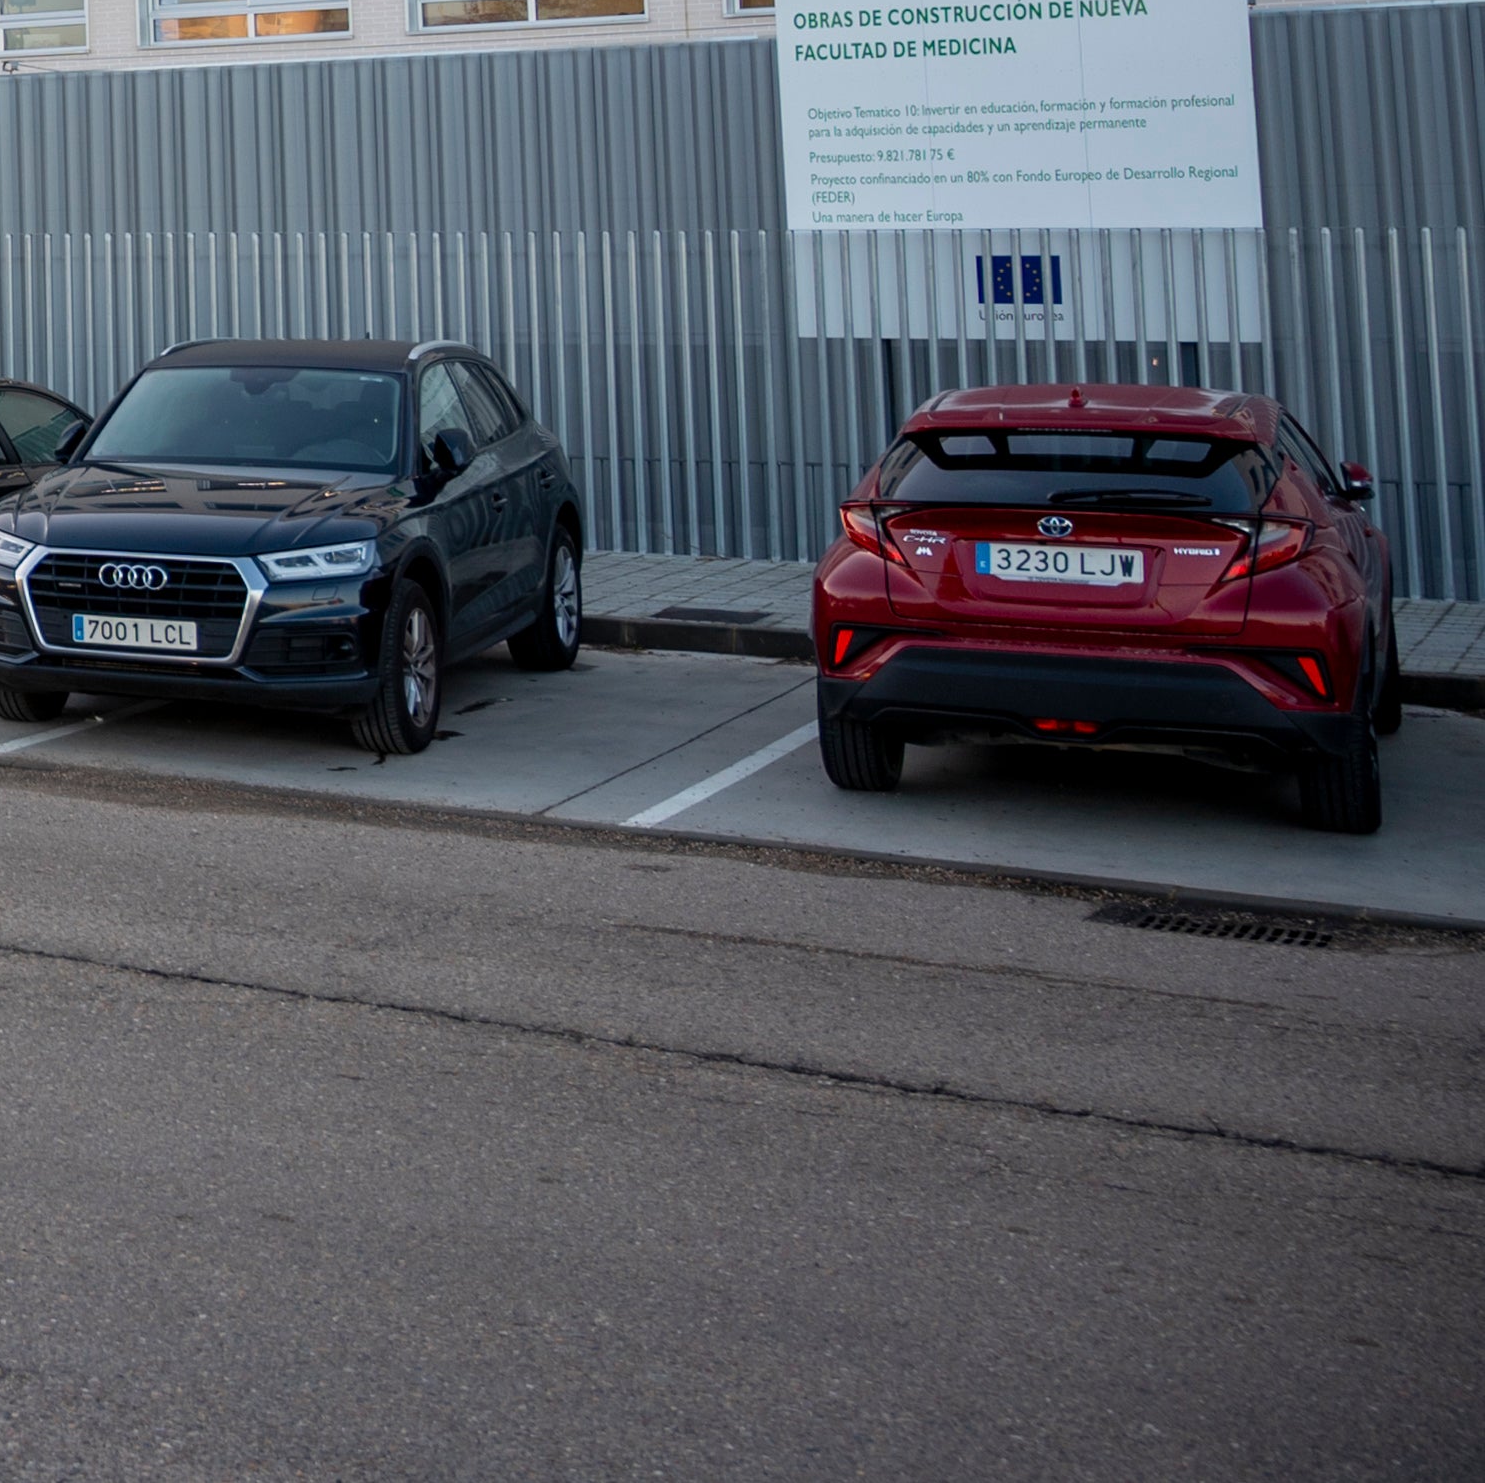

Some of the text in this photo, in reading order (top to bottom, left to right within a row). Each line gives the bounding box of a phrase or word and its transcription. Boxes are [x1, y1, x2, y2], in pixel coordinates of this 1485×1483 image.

[793, 10, 854, 30] OBRAS
[858, 10, 882, 27] DE
[1048, 1, 1074, 19] DE
[794, 36, 1018, 62] FACULTAD DE MEDICINA
[807, 94, 1235, 122] Objetivo Tematico 10: Invertir en educación, formación y formación profesional
[808, 118, 1147, 140] para la adquisición de capacidades y un aprendizaje permanente
[809, 151, 876, 166] Presupuesto:
[946, 148, 956, 161] €
[810, 173, 857, 187] Proyecto
[933, 174, 947, 184] en
[950, 173, 964, 183] un
[966, 170, 990, 183] 80%
[992, 172, 1013, 183] con
[1016, 168, 1051, 182] Fondo
[1055, 168, 1102, 184] Europeo
[1106, 168, 1120, 180] de
[1123, 166, 1185, 180] Desarrollo
[1188, 165, 1238, 181] Regional
[811, 191, 856, 206] (FEDER)
[812, 210, 964, 224] Una manera de hacer Europa
[978, 309, 1014, 322] Uión
[996, 548, 1069, 574] 3230
[1080, 552, 1135, 578] LJW
[88, 620, 191, 645] 7001 LCL
